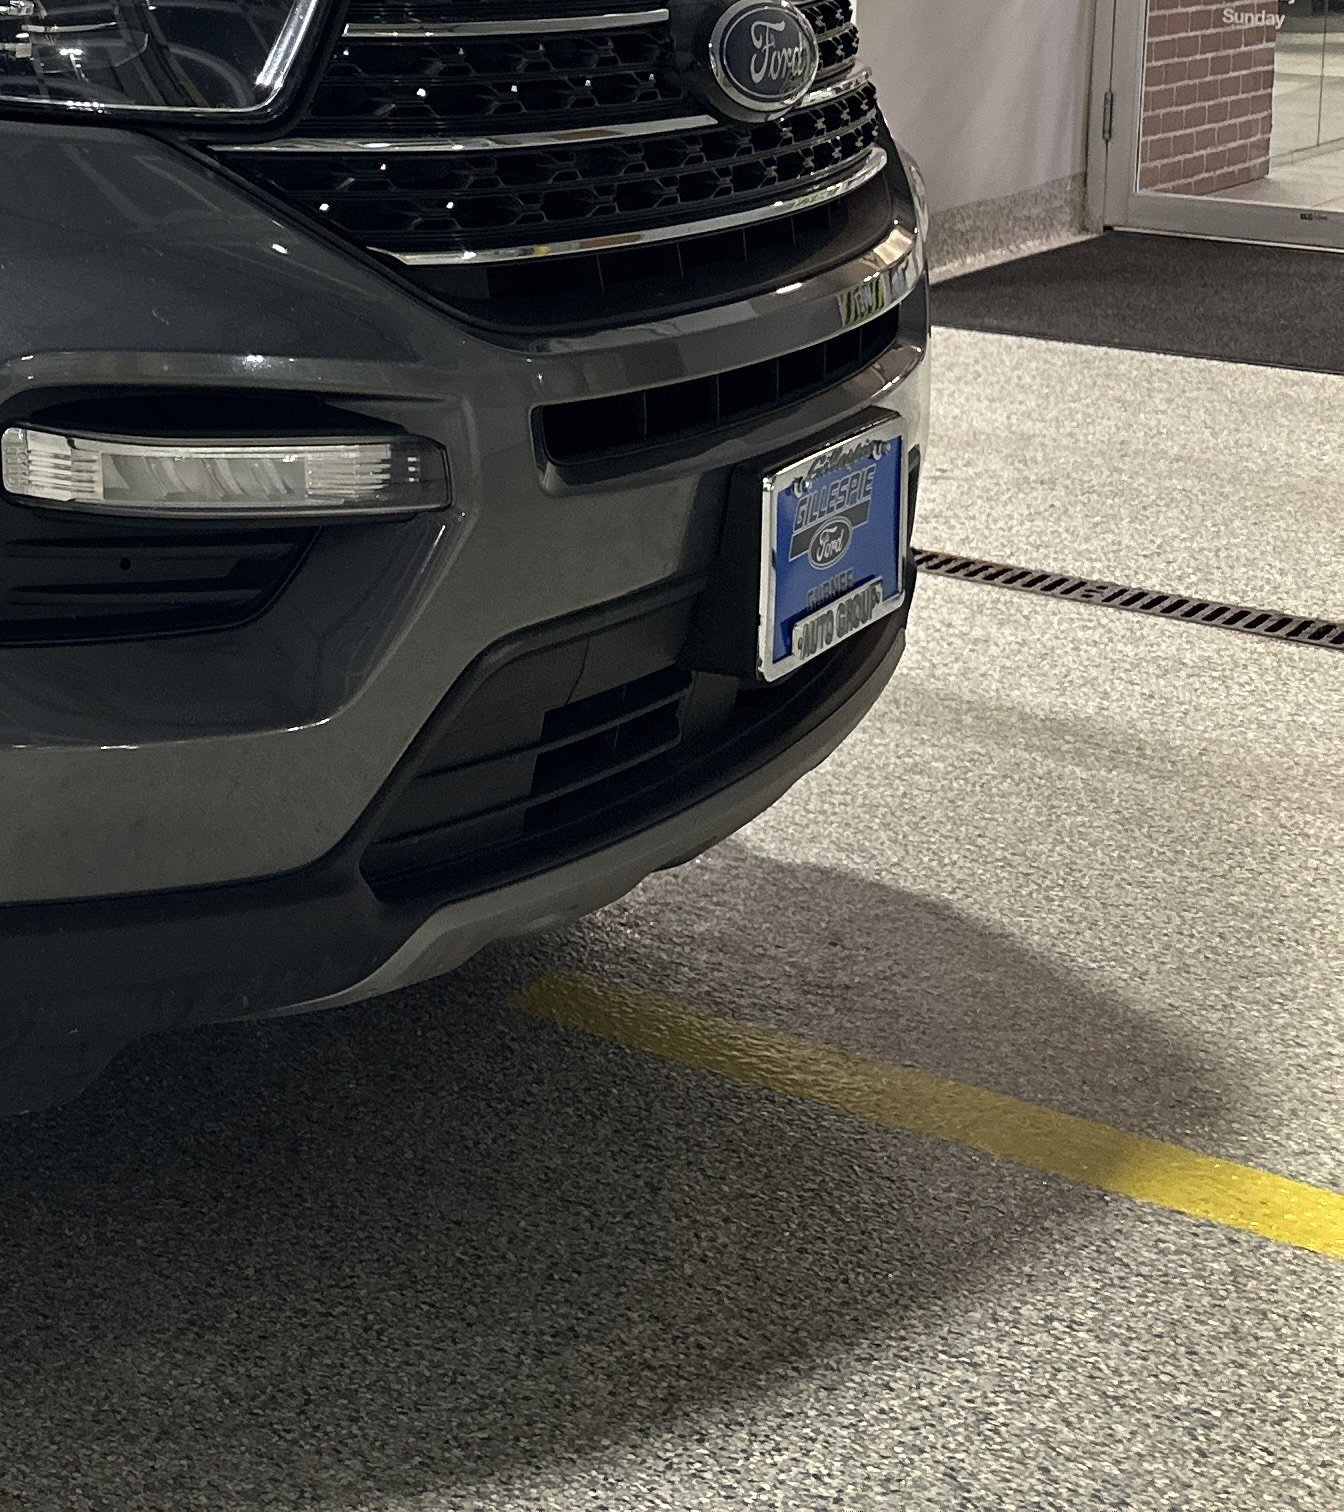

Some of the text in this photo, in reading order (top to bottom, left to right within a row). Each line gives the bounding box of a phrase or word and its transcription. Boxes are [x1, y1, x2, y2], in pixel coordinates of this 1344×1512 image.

[1222, 8, 1285, 30] Sunday
[750, 20, 806, 84] Ford
[794, 462, 876, 533] GILLESPIE
[815, 526, 845, 562] Ford
[800, 585, 878, 660] AUTO GROUP
